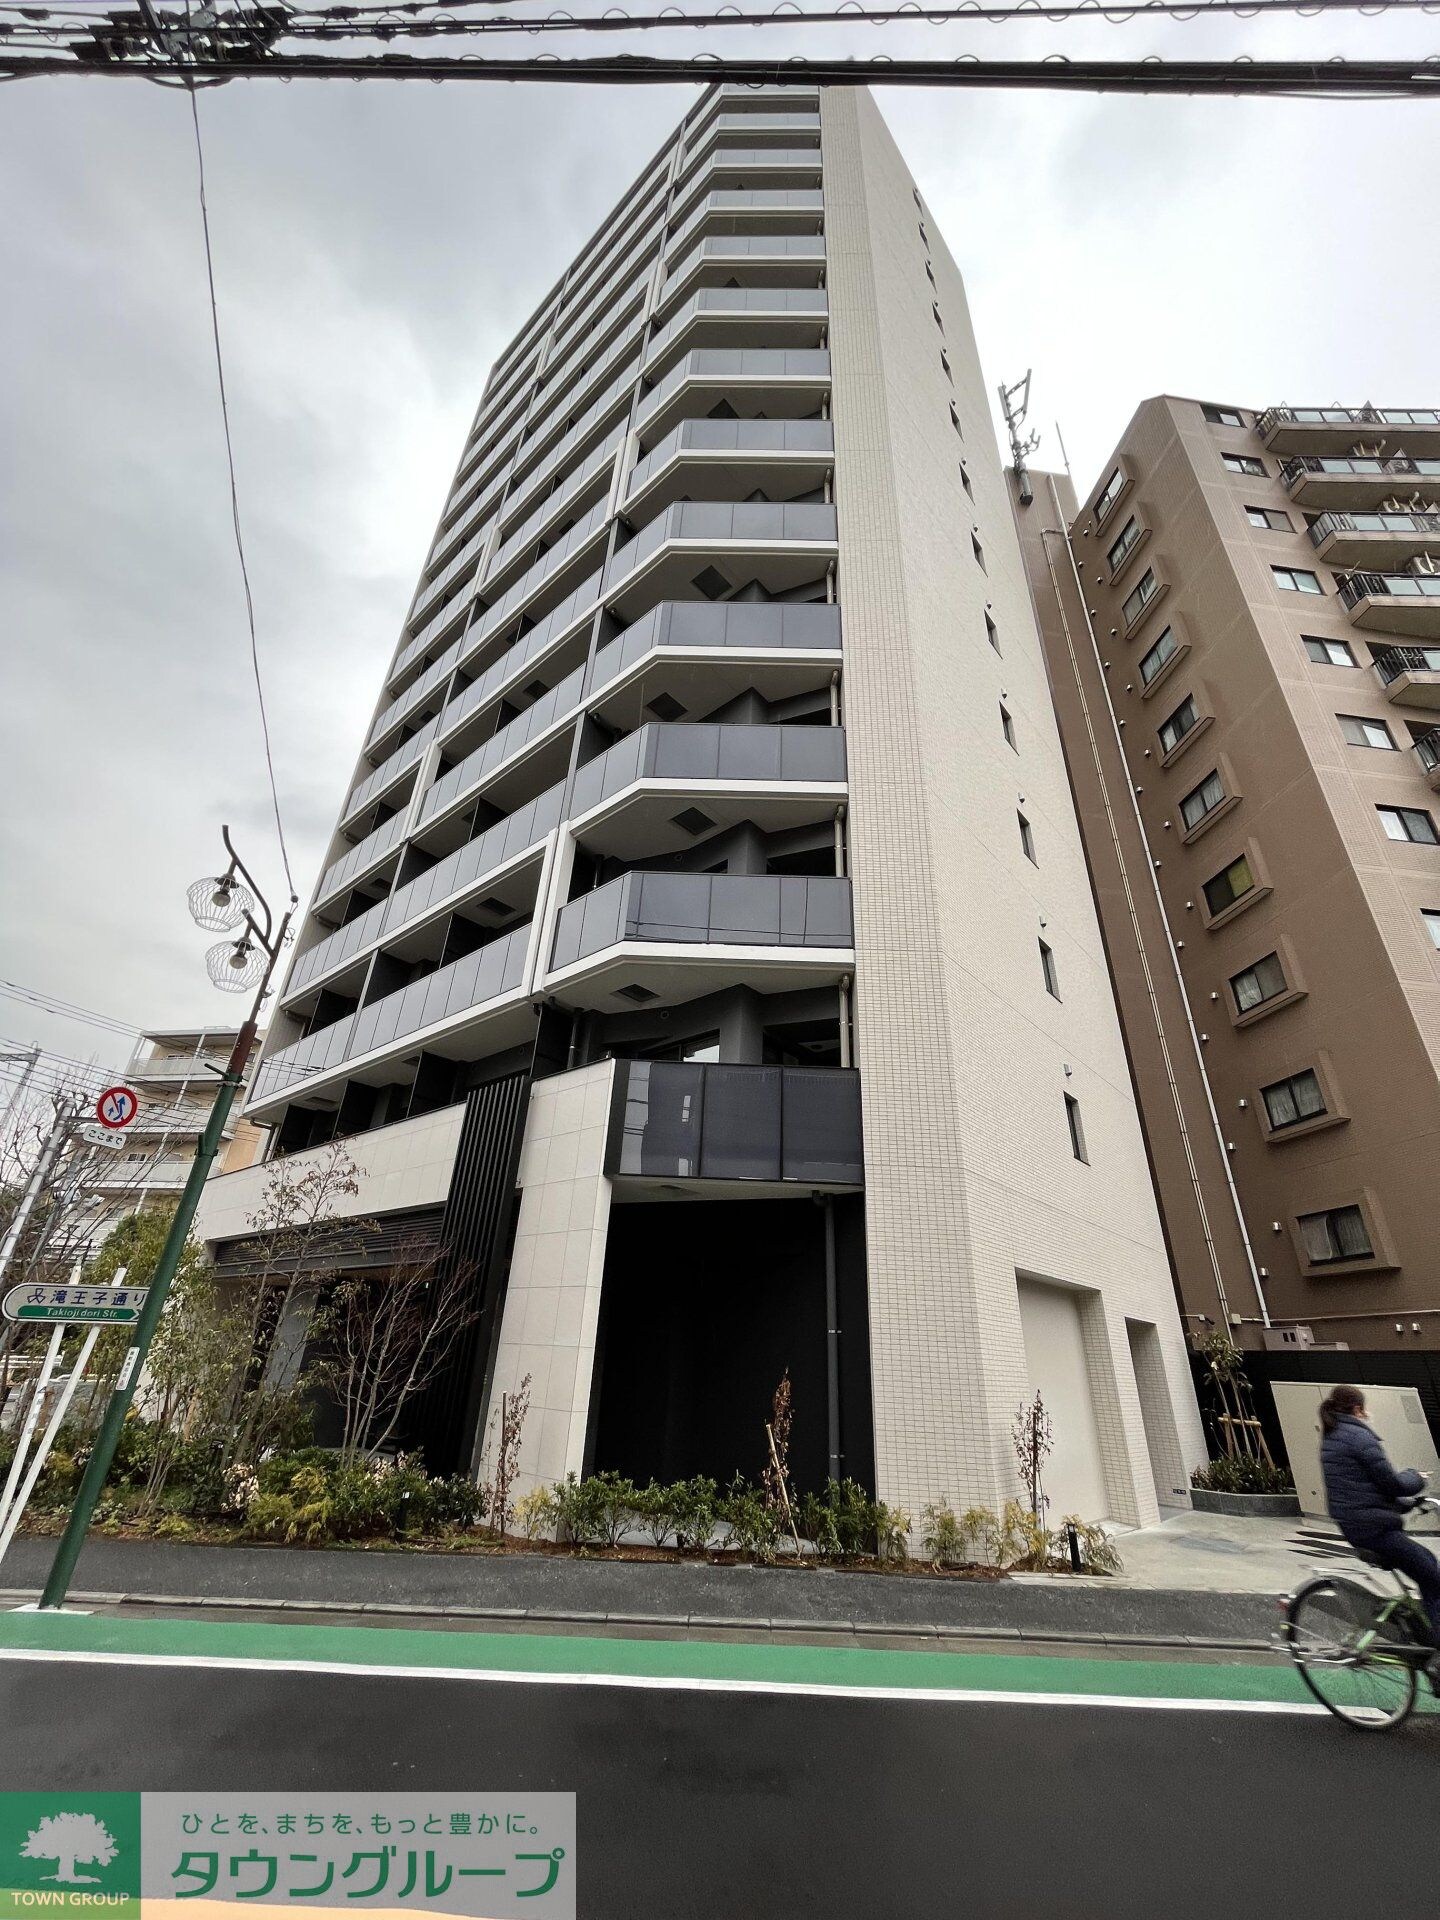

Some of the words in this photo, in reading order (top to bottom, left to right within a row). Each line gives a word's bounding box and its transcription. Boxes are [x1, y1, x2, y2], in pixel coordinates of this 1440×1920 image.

[88, 1129, 123, 1145] ここまで
[50, 1290, 146, 1306] 滝王子通り
[102, 1310, 118, 1318] Str.
